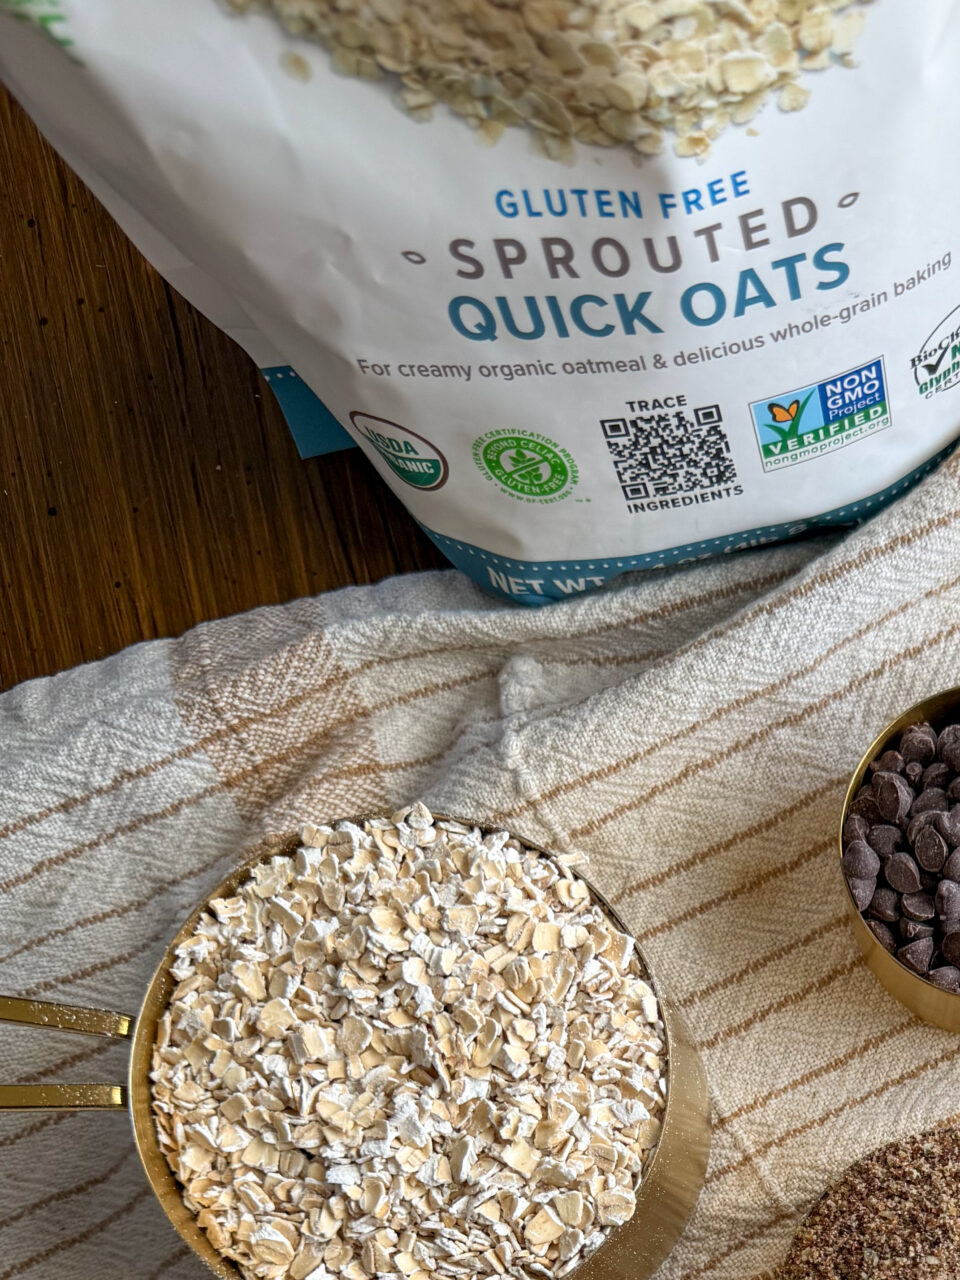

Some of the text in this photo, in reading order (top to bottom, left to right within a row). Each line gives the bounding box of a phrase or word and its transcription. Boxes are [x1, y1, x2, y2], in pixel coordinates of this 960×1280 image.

[495, 170, 750, 219] GLUTEN FREE
[449, 196, 818, 280] SPROUTED
[448, 242, 850, 342] QUICK OATS
[357, 251, 952, 382] For creamy organic oatmeal & delicious whole-grain baking
[825, 365, 877, 396] NON
[827, 380, 880, 409] GMO
[625, 395, 687, 413] TRACE
[829, 392, 881, 421] Project
[764, 416, 890, 468] nongmoproject.org
[768, 405, 883, 455] VERIFIED
[520, 440, 561, 465] CELIAC
[627, 485, 744, 514] INGREDIENTS
[486, 566, 544, 596] NET
[553, 576, 605, 595] WT
